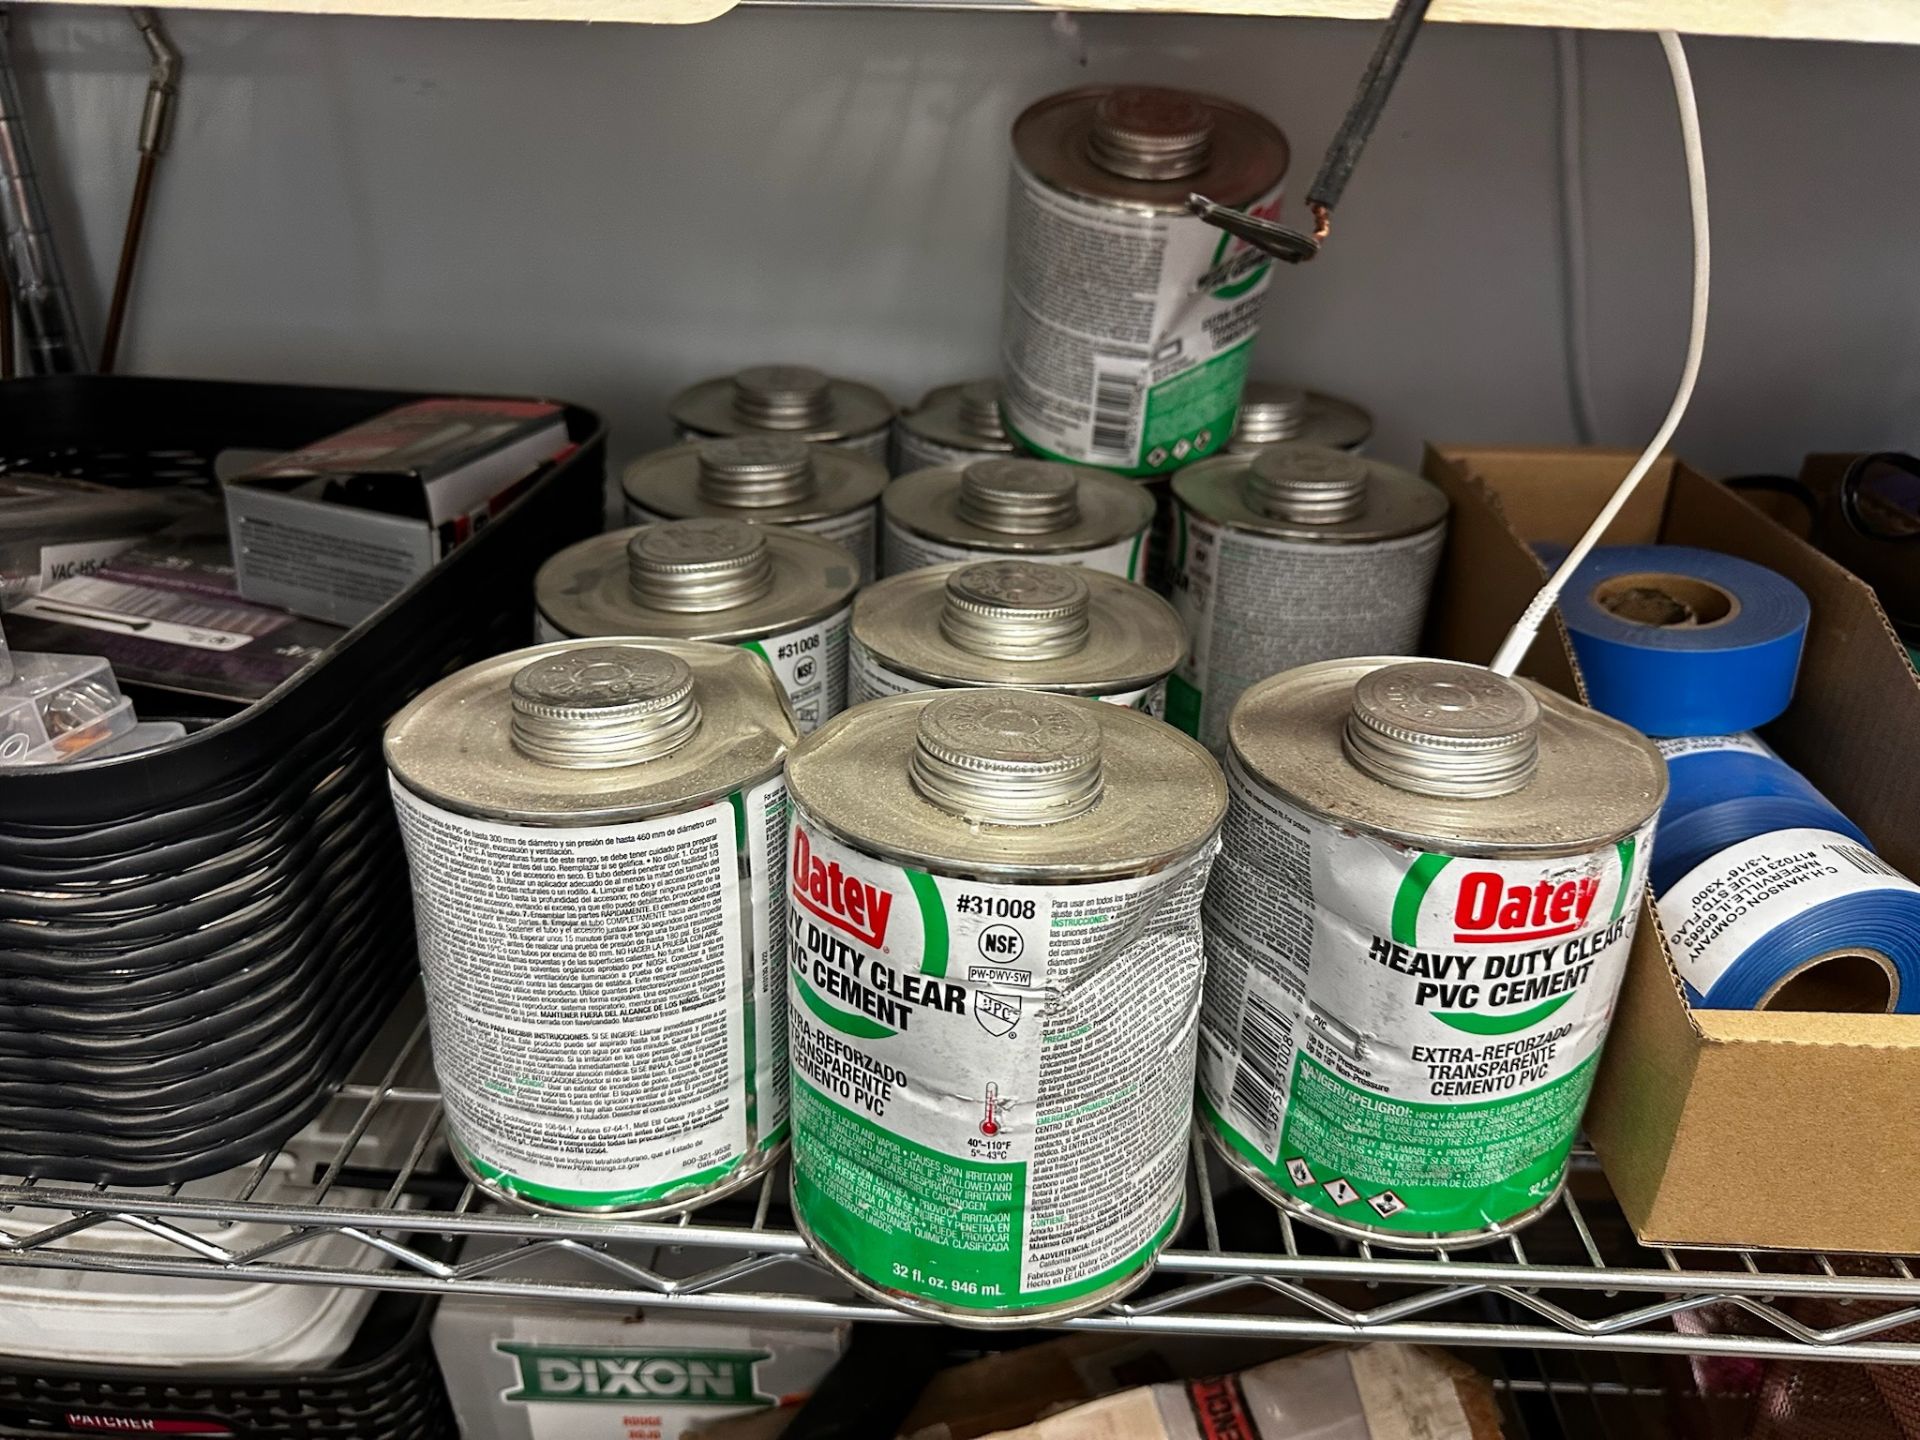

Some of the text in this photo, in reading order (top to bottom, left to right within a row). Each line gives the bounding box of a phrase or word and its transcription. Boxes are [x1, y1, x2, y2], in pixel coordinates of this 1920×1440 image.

[778, 633, 820, 660] #31008
[797, 662, 813, 679] NSF
[489, 834, 503, 843] 300
[503, 837, 516, 845] mm
[528, 839, 559, 848] diámetro
[565, 839, 577, 847] sin
[578, 837, 604, 849] presión
[605, 837, 615, 846] de
[616, 835, 635, 844] hasta
[637, 832, 651, 841] 460
[652, 830, 666, 839] mm
[667, 828, 676, 836] de
[677, 821, 704, 834] diámetro
[705, 818, 717, 826] con
[610, 852, 628, 861] debe
[629, 850, 647, 860] tener
[649, 845, 675, 857] cuidado
[677, 842, 691, 852] para
[692, 834, 718, 848] preparar
[690, 842, 719, 855] Cortar los
[638, 862, 666, 874] penetrar
[1767, 850, 1818, 870] #17023
[793, 824, 893, 949] Oatey
[1727, 867, 1768, 892] BLUE
[956, 893, 1036, 920] #31008
[1050, 908, 1074, 919] ajuste
[1075, 908, 1083, 917] de
[1051, 893, 1123, 908] Para usar en todos los
[1454, 871, 1600, 934] Oatey
[1688, 866, 1839, 963] C.H.HANSON COMPANY
[1049, 937, 1081, 948] extremos
[1061, 928, 1088, 938] uniones
[1683, 912, 1718, 948] 60563
[1368, 915, 1626, 981] HEAVY DUTY CLEAR
[807, 922, 865, 979] DUTY
[870, 961, 967, 1016] CLEAR
[970, 968, 1029, 984] PW-DWV-SW
[813, 959, 913, 1031] CEMENT
[1415, 960, 1595, 1009] PVC CEMENT
[604, 1009, 617, 1017] DEL
[654, 1003, 663, 1012] DE
[665, 1000, 678, 1010] LOS
[1312, 1014, 1327, 1030] PVC
[1273, 1034, 1294, 1082] 31008
[1411, 1023, 1573, 1063] EXTRA-REFORZADO
[791, 1020, 892, 1102] TRANSPARENTE
[1337, 1053, 1371, 1077] Pressure
[1427, 1042, 1557, 1080] TRANSPARENTE
[793, 1043, 884, 1117] CEMENTO PVC
[1335, 1062, 1390, 1093] Non-Pressure
[1430, 1062, 1549, 1096] CEMENTO PVC
[903, 1158, 1013, 1192] FATAL SWALLOWED AND
[909, 1151, 941, 1171] CAUSES
[943, 1163, 963, 1179] SKIN
[965, 1170, 1013, 1182] IRRITATION
[909, 1171, 1012, 1201] RESPIRATORY IRRITATION
[857, 1176, 871, 1191] SER
[903, 1200, 914, 1213] SE
[954, 1220, 995, 1233] PENETRA
[997, 1223, 1010, 1233] EN
[929, 1224, 1010, 1242] PUEDE PROVOCAR
[952, 1239, 1010, 1252] CLASIFICADA
[1039, 1242, 1091, 1261] ADVERTENCIA:
[892, 1262, 1002, 1296] 32 fl. oz. 946 mL
[1026, 1267, 1064, 1281] Fabricado
[1065, 1264, 1076, 1275] por
[1026, 1278, 1051, 1289] Hecho
[1052, 1277, 1062, 1286] en
[537, 1357, 737, 1396] DIXON
